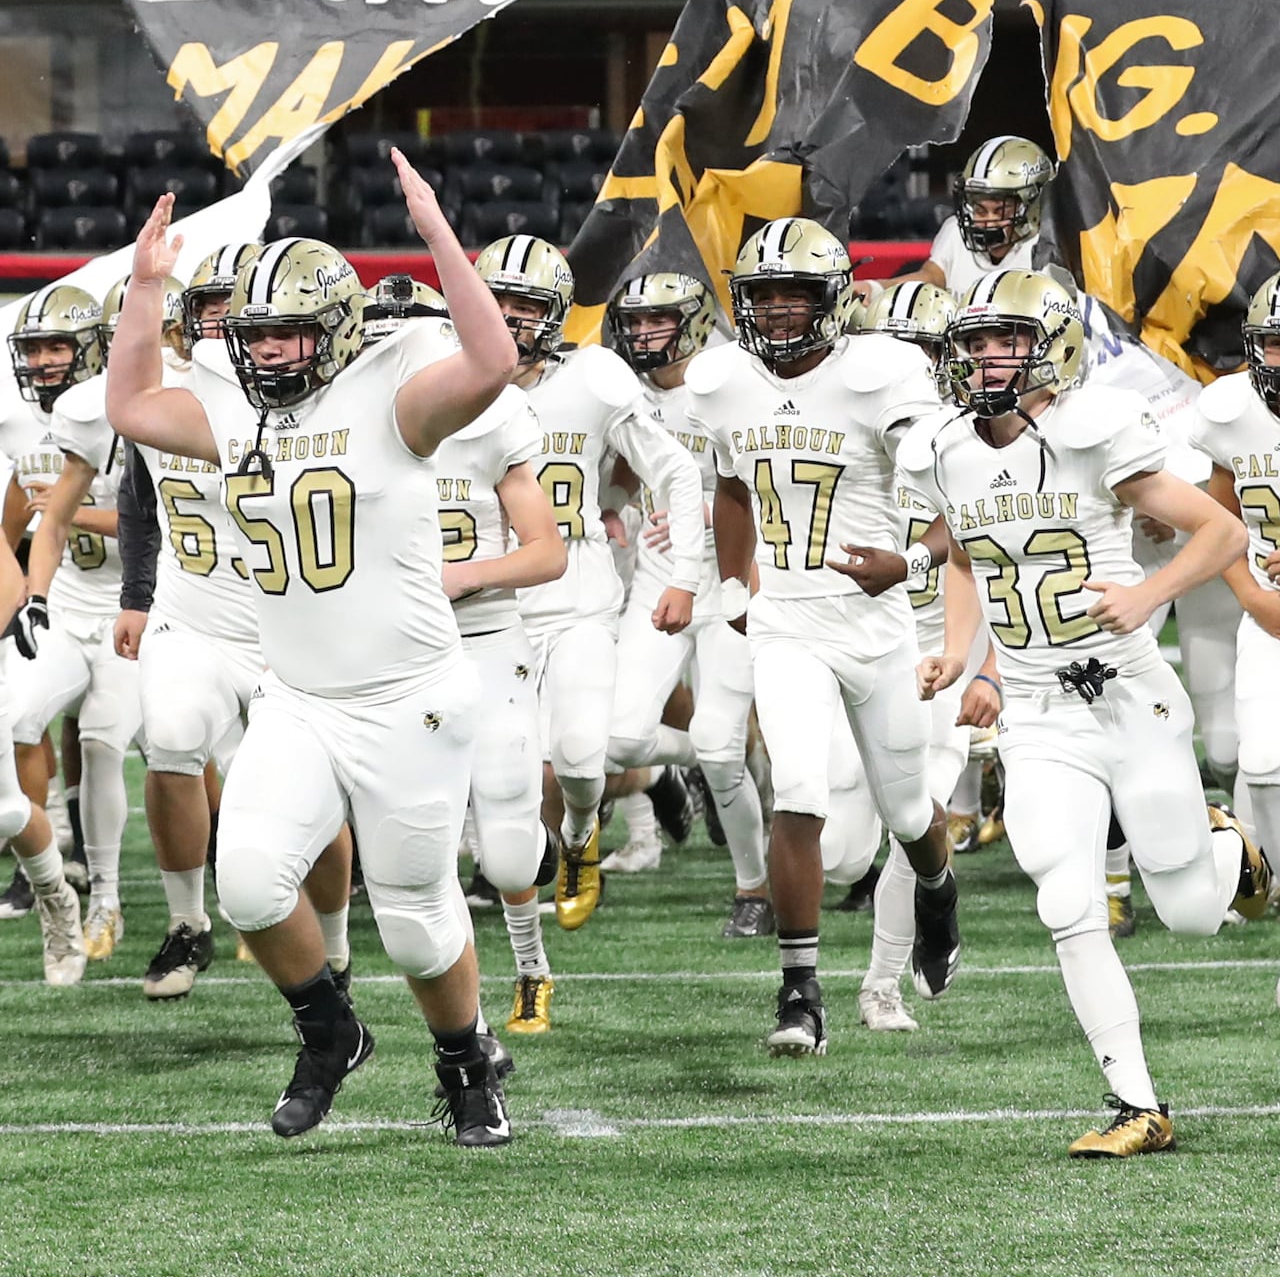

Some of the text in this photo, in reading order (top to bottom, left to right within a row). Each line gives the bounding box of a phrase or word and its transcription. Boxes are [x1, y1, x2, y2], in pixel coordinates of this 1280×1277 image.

[228, 428, 350, 465] CALHOUN
[732, 425, 846, 455] CALHOUN
[225, 466, 356, 595] 50
[754, 458, 846, 571] 47
[946, 492, 1079, 530] CALHOUN
[961, 529, 1101, 649] 32
